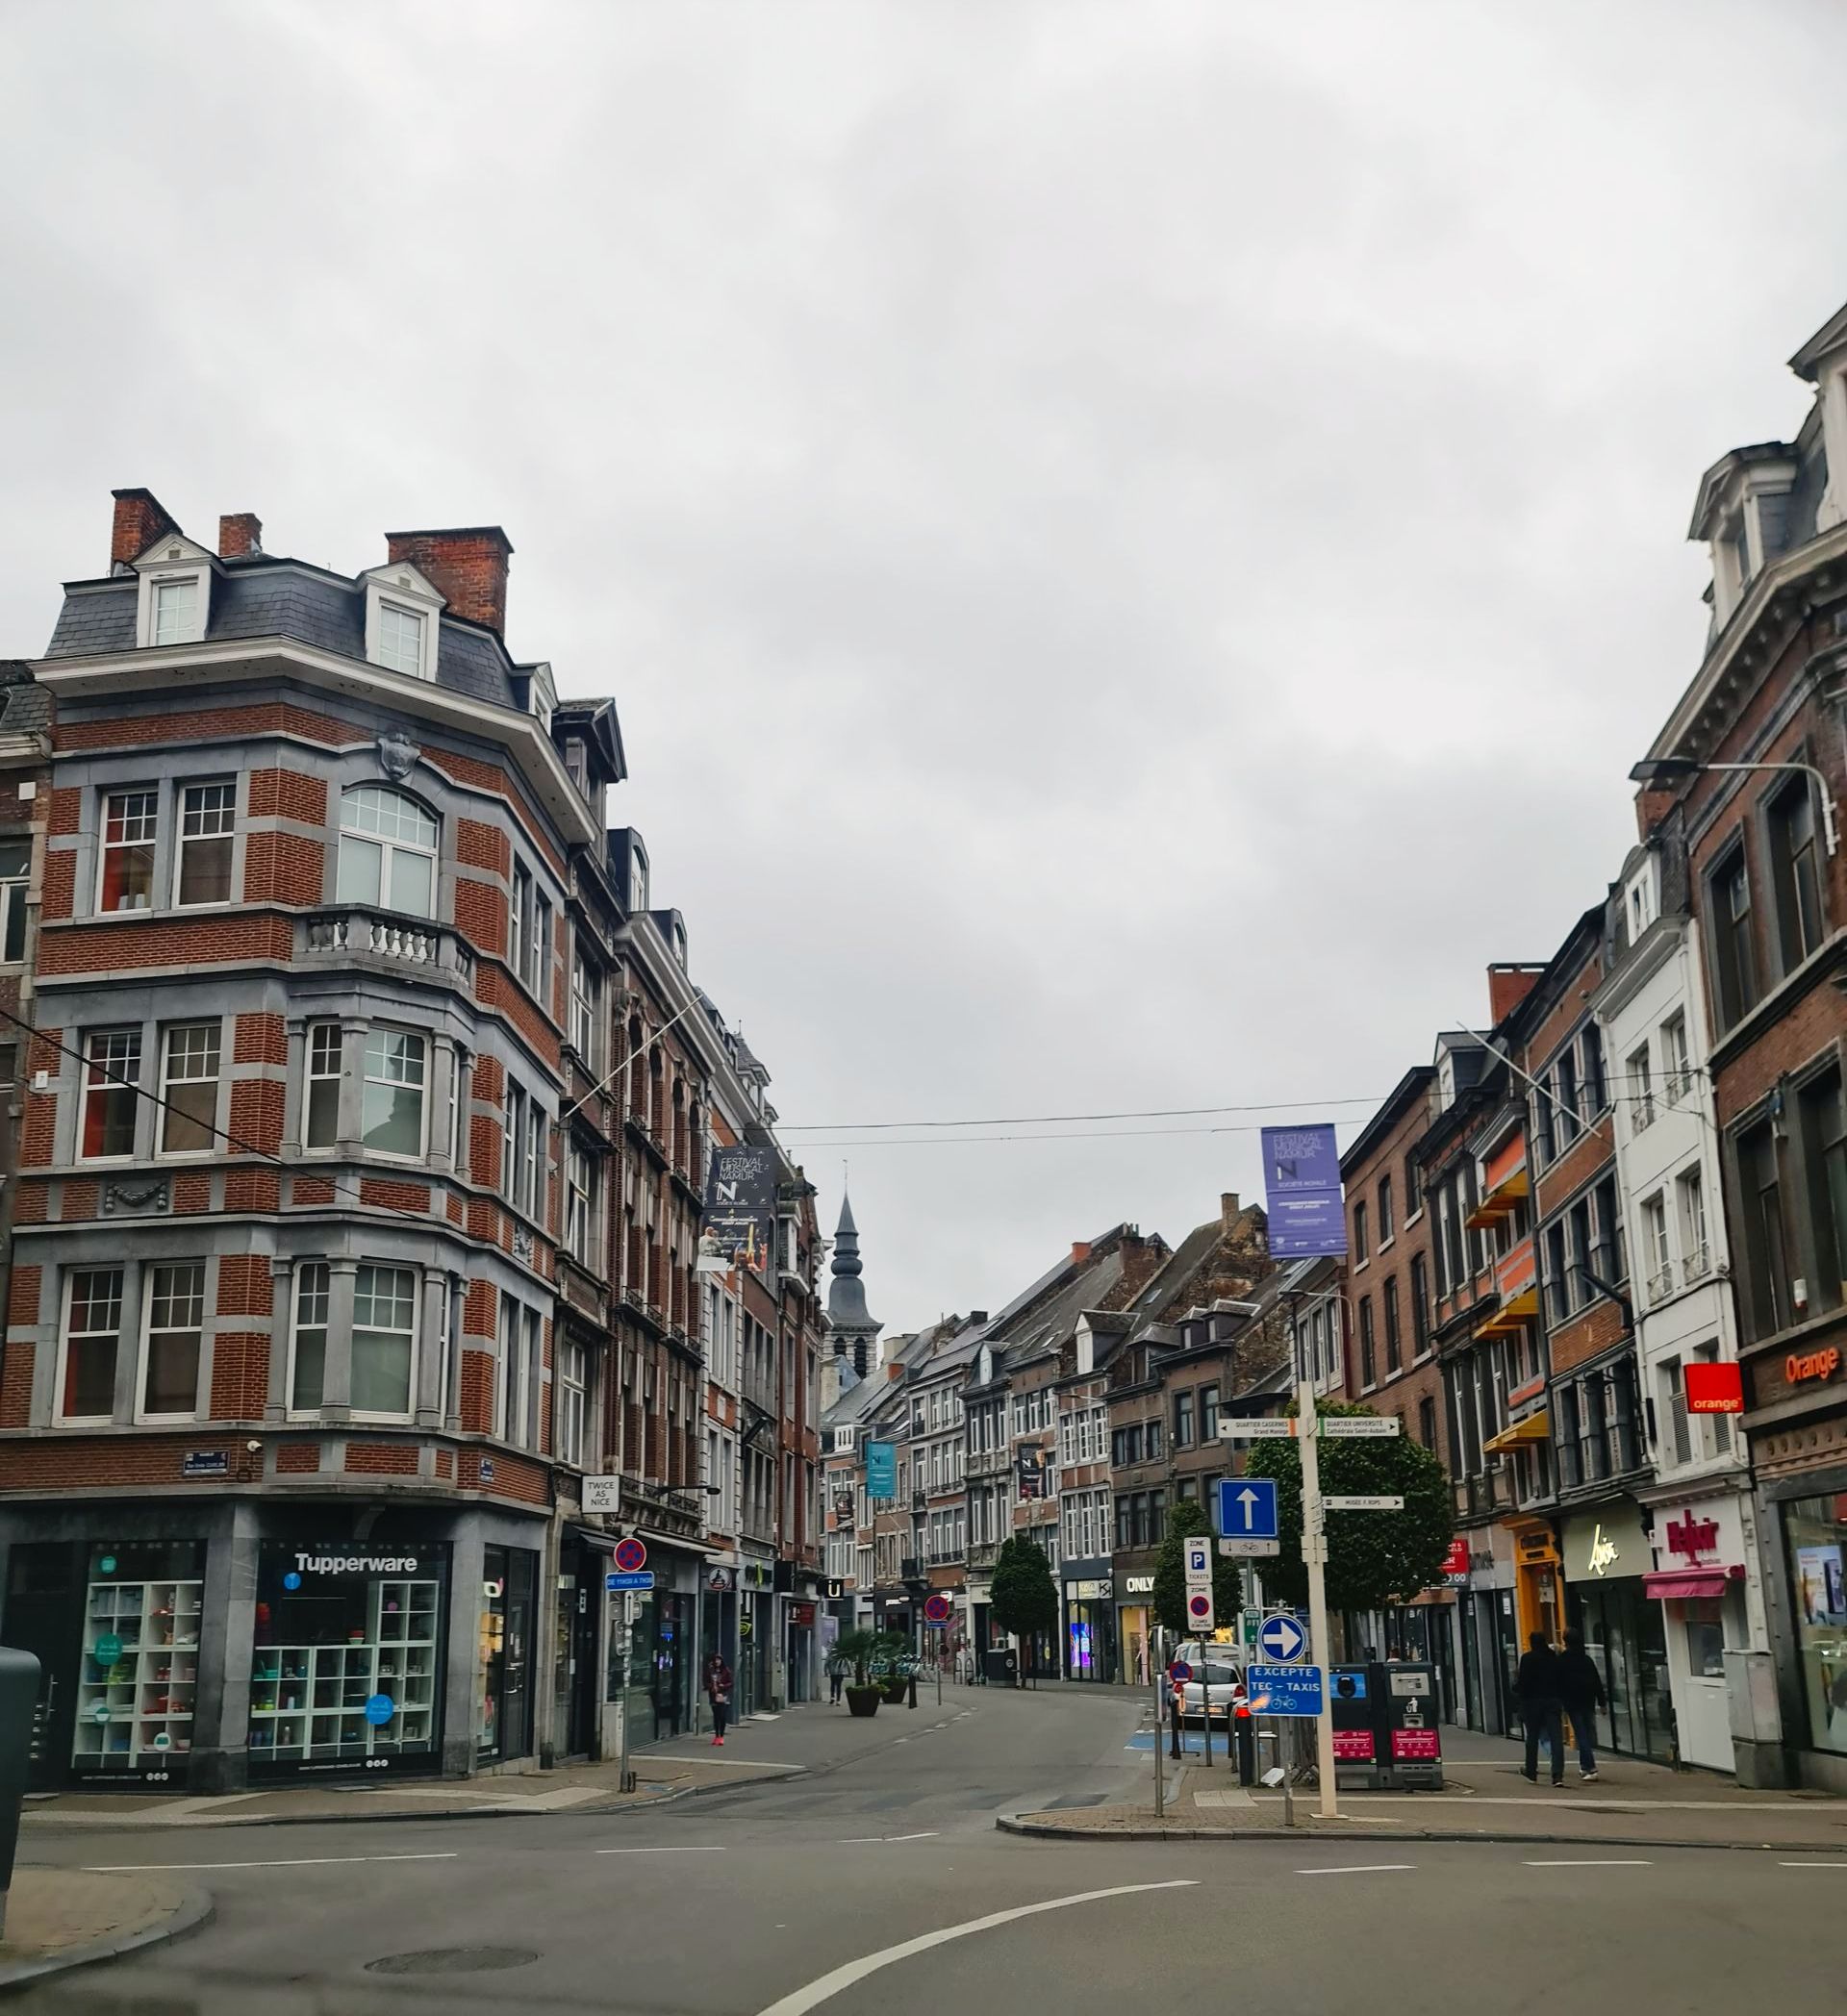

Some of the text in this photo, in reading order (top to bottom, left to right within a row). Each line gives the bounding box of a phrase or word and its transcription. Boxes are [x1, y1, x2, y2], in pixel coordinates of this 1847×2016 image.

[721, 1157, 763, 1166] FESTIVAL
[721, 1165, 763, 1173] MUSICAL
[719, 1172, 755, 1181] NAMUR
[1785, 1347, 1839, 1383] Orange
[1693, 1399, 1739, 1411] orange
[587, 1481, 615, 1490] TWICE
[294, 1552, 417, 1575] Tupperware
[1193, 1554, 1202, 1568] P
[1126, 1576, 1155, 1593] ONLY
[1254, 1667, 1314, 1677] EXCEPTE
[1251, 1681, 1274, 1691] TEC
[1286, 1682, 1321, 1692] TAXIS
